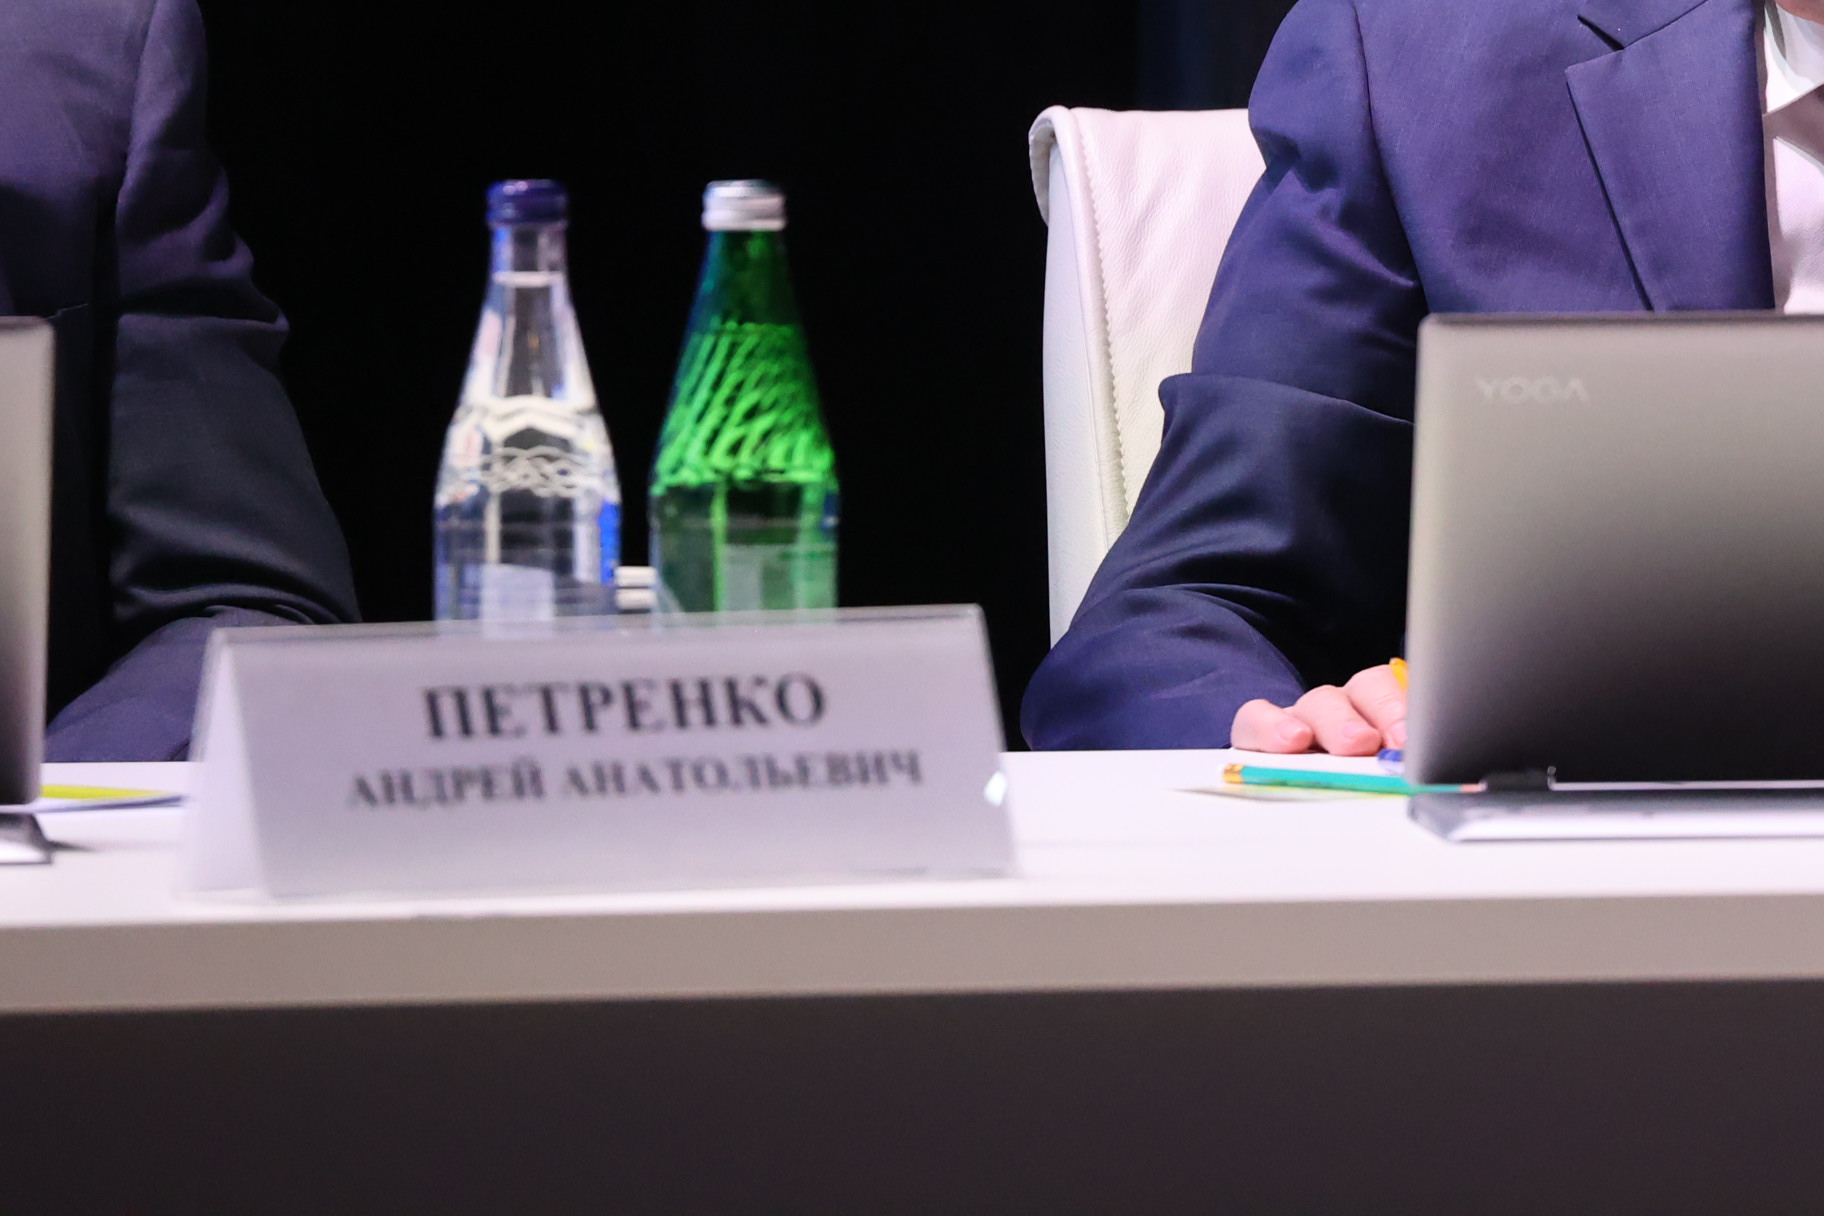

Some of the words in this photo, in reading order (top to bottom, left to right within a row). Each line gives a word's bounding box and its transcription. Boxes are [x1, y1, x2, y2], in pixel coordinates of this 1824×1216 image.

[1475, 375, 1588, 403] YOGA
[423, 673, 826, 741] ПЕТРЕНКО
[350, 757, 545, 810] АНДРЕЙ
[563, 751, 923, 800] АНАТОЛЬЕВИЧ
